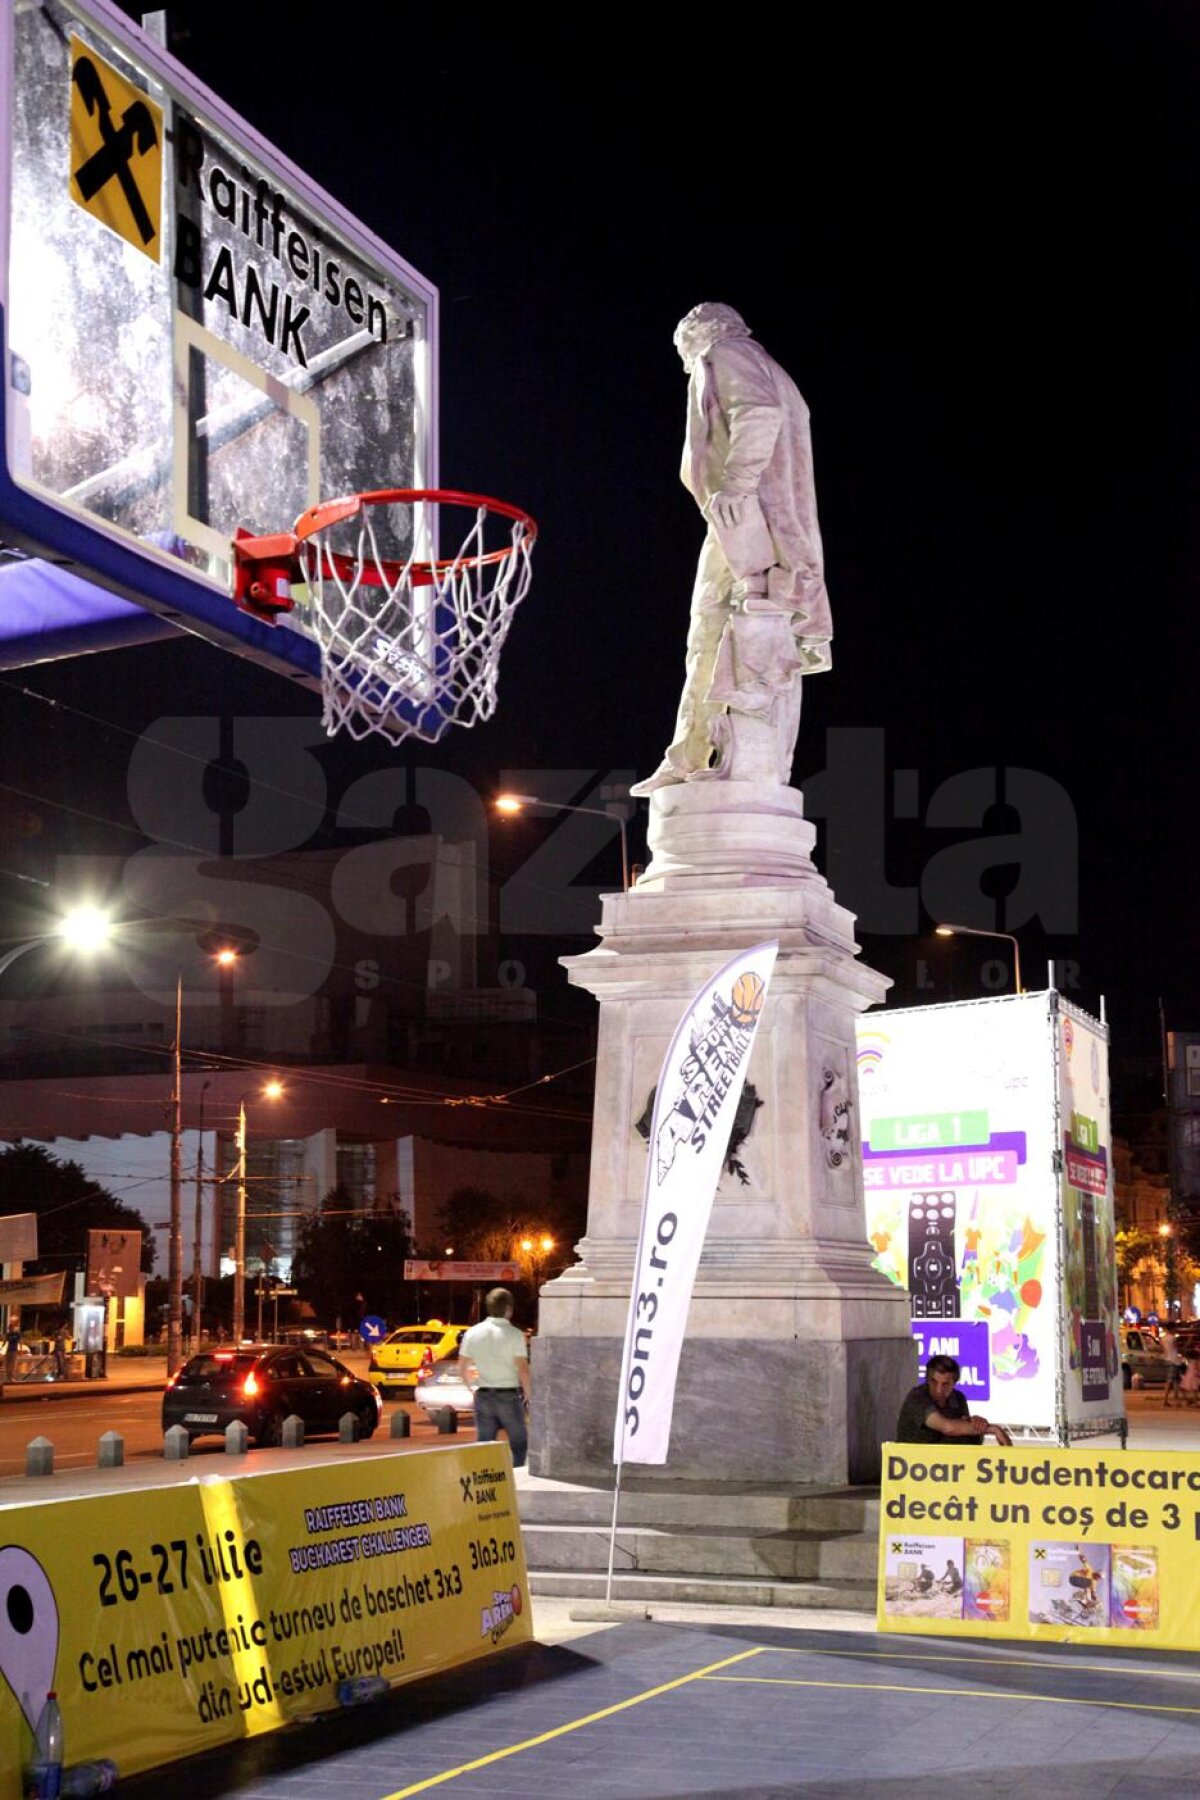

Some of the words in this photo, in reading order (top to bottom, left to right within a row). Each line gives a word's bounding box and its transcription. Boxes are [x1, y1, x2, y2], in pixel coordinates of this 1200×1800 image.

[180, 117, 388, 345] Raiffeisen
[174, 213, 309, 369] BANK
[691, 1033, 752, 1154] STREETBALL
[894, 1122, 941, 1145] LIGA
[952, 1116, 961, 1142] 1
[863, 1165, 887, 1188] SE
[889, 1163, 936, 1186] VEDE
[939, 1161, 964, 1183] LA
[968, 1155, 1005, 1181] UPC
[624, 1210, 679, 1438] 3on3.ro
[928, 1336, 960, 1356] ANI
[887, 1456, 965, 1484] Doar
[304, 1501, 376, 1534] RAIFFEISEN
[375, 1494, 408, 1520] BANK
[476, 1487, 497, 1505] BANK
[886, 1494, 978, 1522] decât
[990, 1503, 1030, 1524] un
[1042, 1503, 1094, 1536] coș
[1105, 1501, 1149, 1529] de
[1162, 1503, 1181, 1530] 3
[288, 1535, 363, 1574] BUCHAREST
[360, 1522, 432, 1559] CHALLENGER
[468, 1538, 515, 1570] 3la3.ro
[93, 1540, 189, 1607] 26-27
[79, 1644, 123, 1692] Cel
[126, 1632, 174, 1681] mai
[269, 1601, 336, 1642] turneu
[340, 1588, 362, 1624] de
[363, 1574, 434, 1617] baschet
[434, 1564, 463, 1600] 3x3
[198, 1681, 233, 1724] din
[331, 1628, 406, 1680] Europei!
